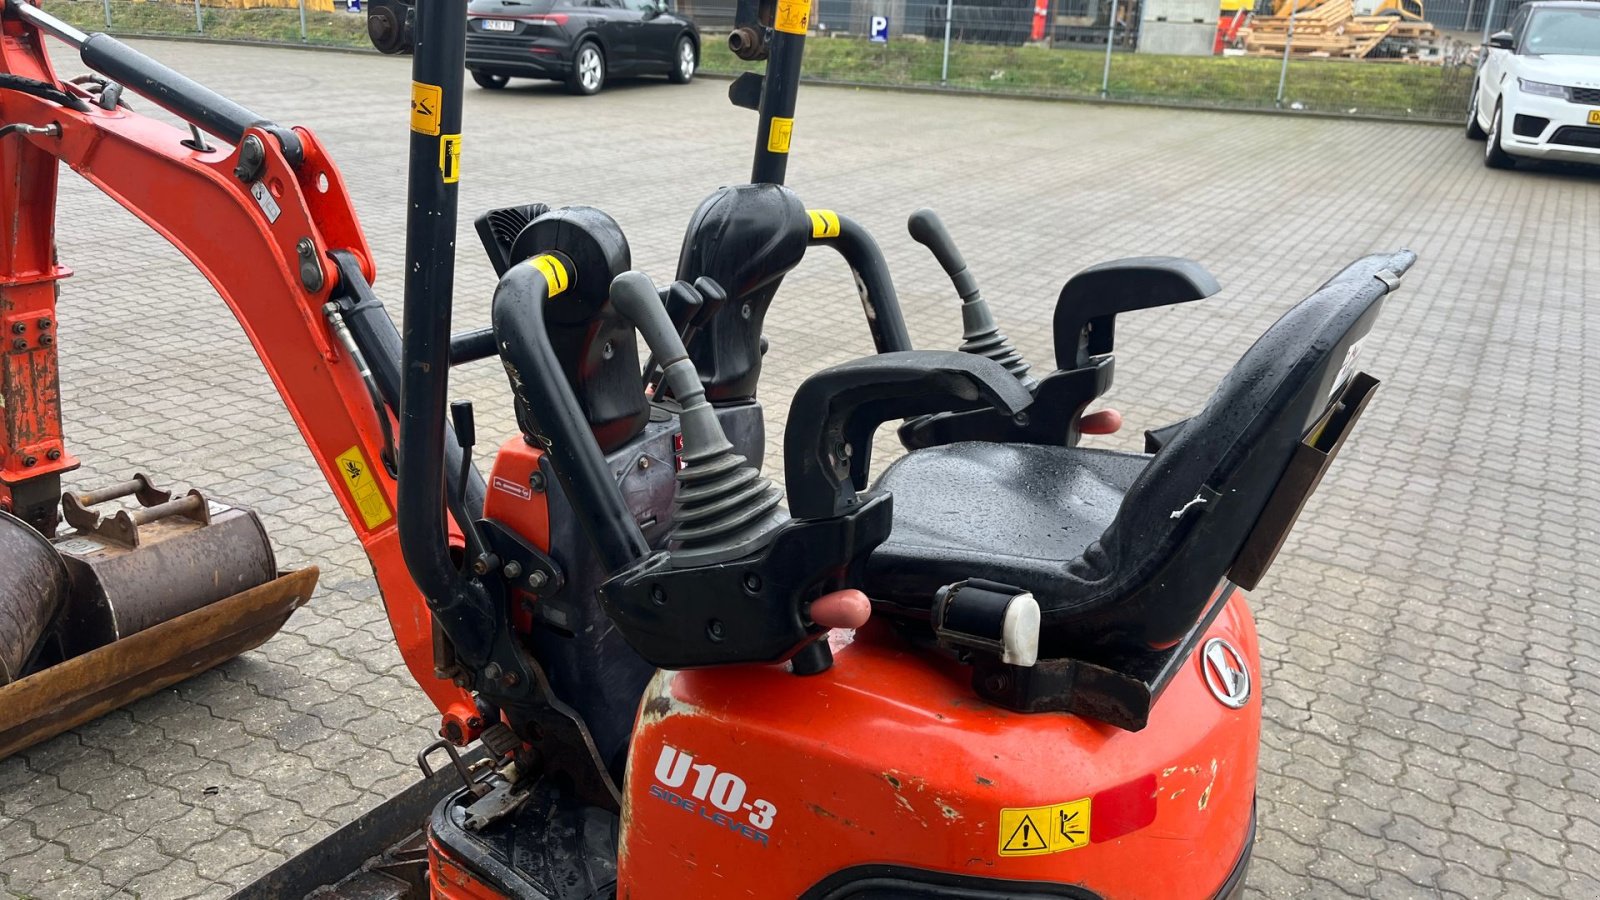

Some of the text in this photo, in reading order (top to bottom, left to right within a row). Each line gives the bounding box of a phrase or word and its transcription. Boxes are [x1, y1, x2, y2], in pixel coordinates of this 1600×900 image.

[871, 16, 887, 36] P
[649, 784, 770, 848] SIDE LEVER
[654, 744, 778, 831] U10-3
